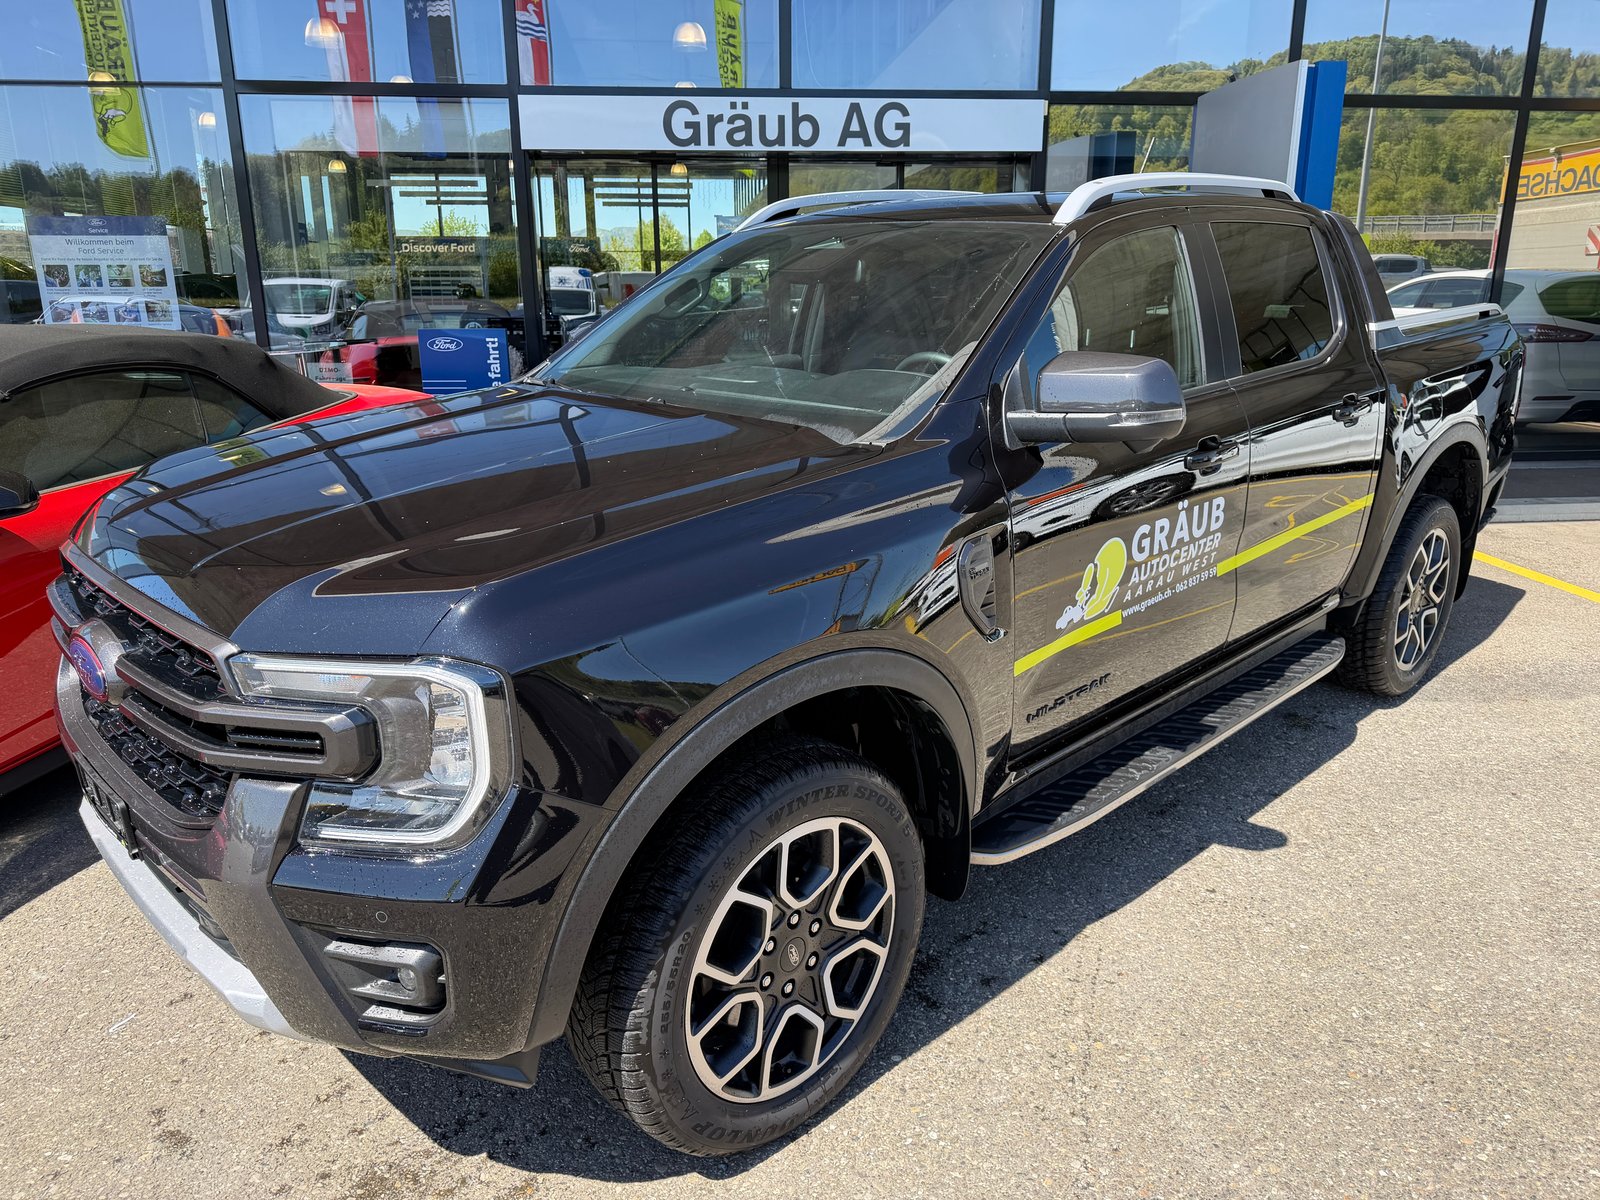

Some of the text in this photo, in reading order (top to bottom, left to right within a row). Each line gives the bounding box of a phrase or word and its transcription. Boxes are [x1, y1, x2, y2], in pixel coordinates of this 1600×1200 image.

[663, 100, 911, 147] Gräub AG
[402, 243, 475, 253] Discover Ford
[569, 244, 589, 253] Ford
[431, 338, 459, 350] Ford
[486, 337, 501, 379] fahrt!
[1132, 497, 1225, 562] GRÄUB
[1123, 552, 1217, 603] AARAU WEST
[1128, 532, 1221, 587] AUTOCENTER
[1122, 587, 1172, 618] www.graeub.ch
[1175, 582, 1188, 593] 062
[1188, 576, 1200, 588] 837
[1200, 570, 1209, 582] 59
[1209, 566, 1217, 578] 59
[766, 784, 849, 828] WINTER
[854, 785, 906, 823] SPORT
